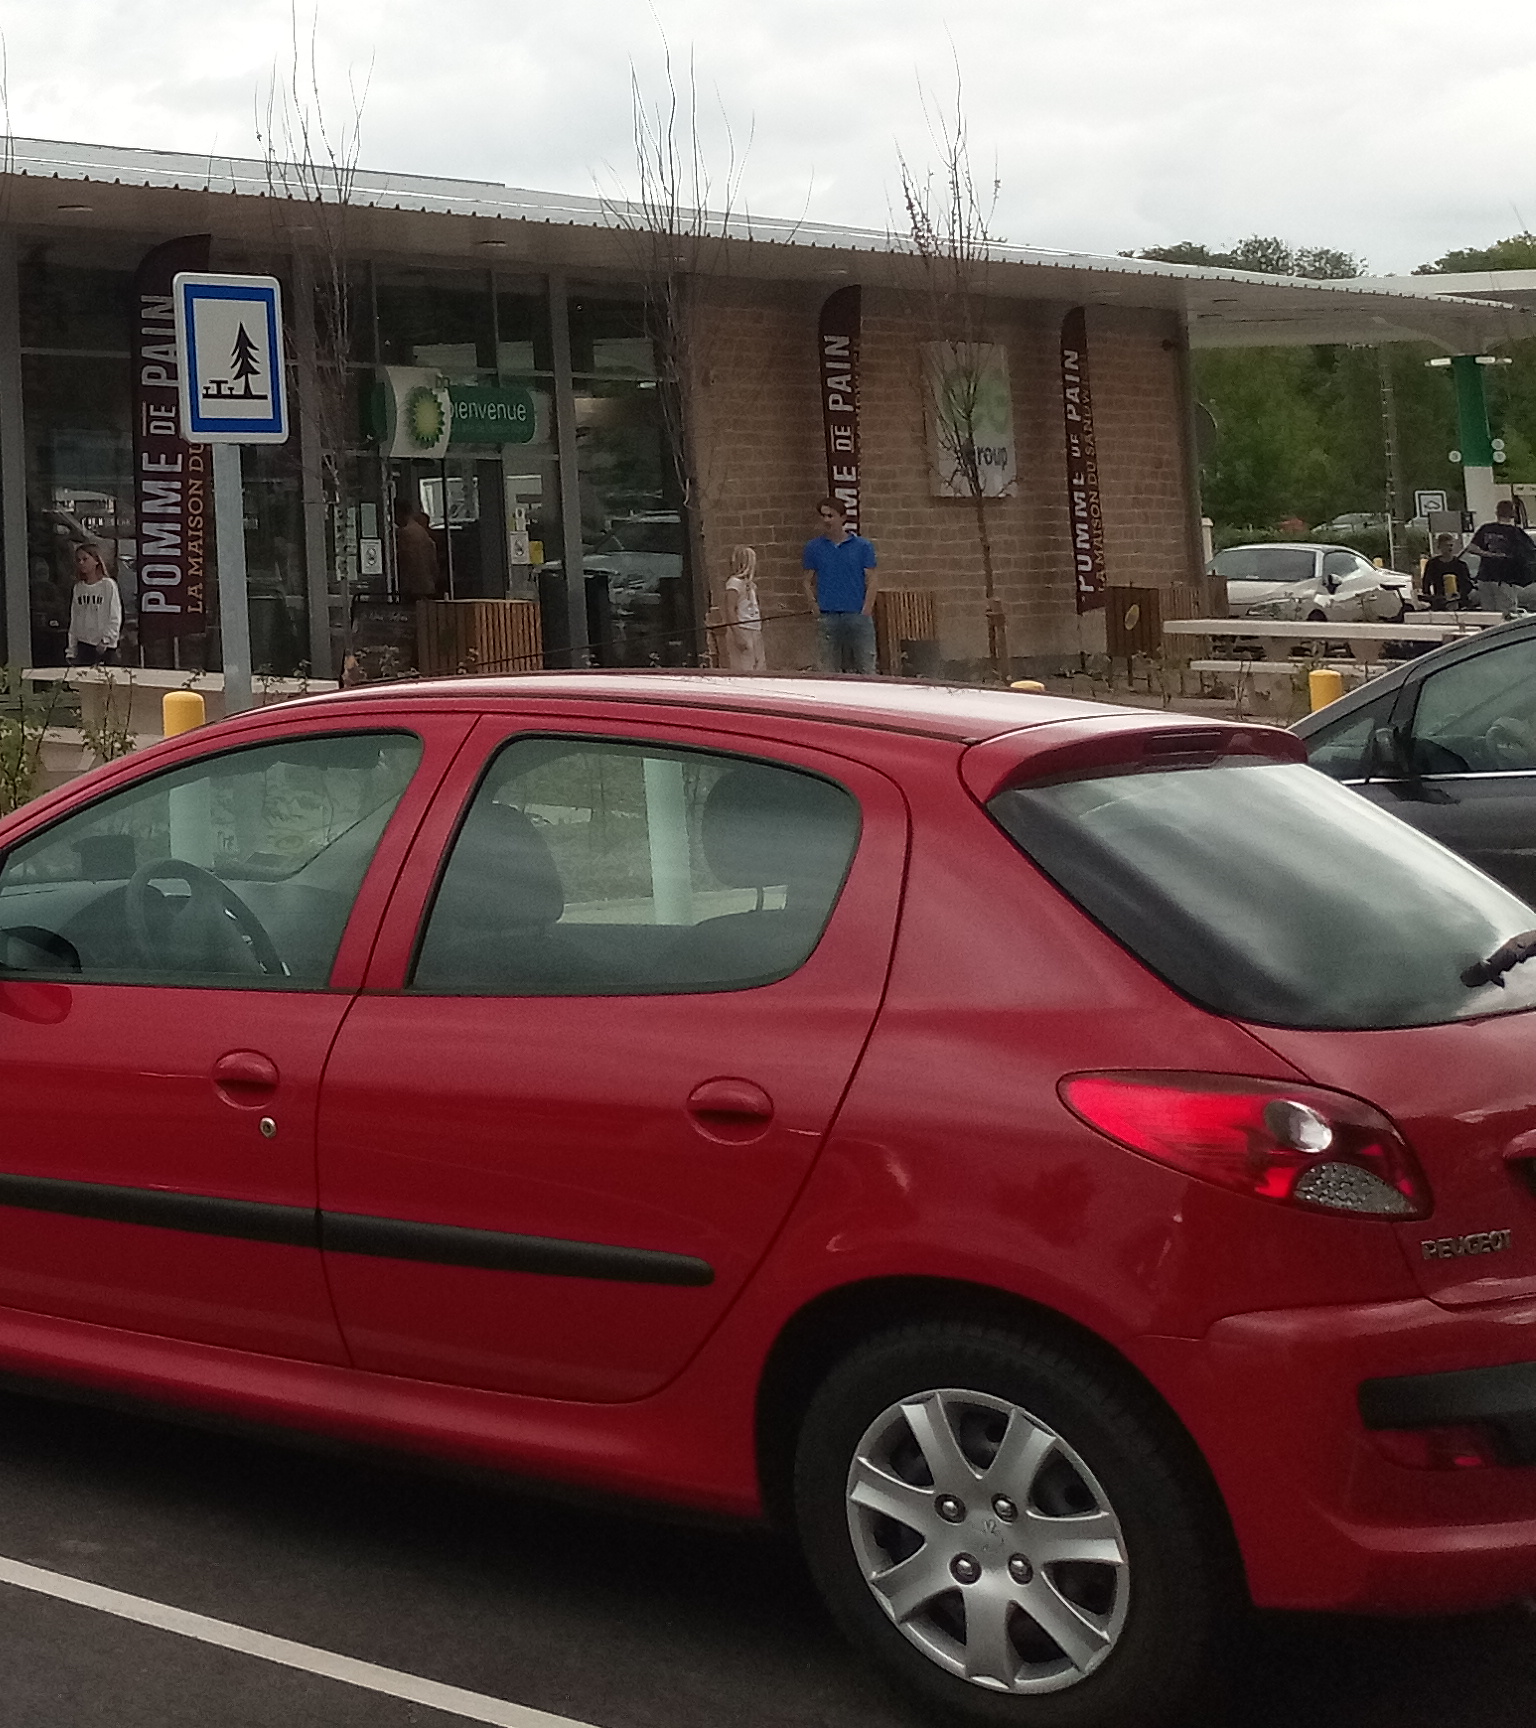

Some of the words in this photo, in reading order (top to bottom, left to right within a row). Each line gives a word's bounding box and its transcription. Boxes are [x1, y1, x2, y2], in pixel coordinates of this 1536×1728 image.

[140, 295, 178, 387] PAIN
[824, 335, 854, 412] PAIN
[149, 404, 176, 435] DE
[1063, 350, 1081, 422] PAIN
[835, 425, 852, 451] DE
[141, 452, 182, 613] POMME
[187, 479, 204, 577] MAISON
[187, 583, 203, 614] LA
[1421, 1229, 1511, 1260] PEUGEOT
